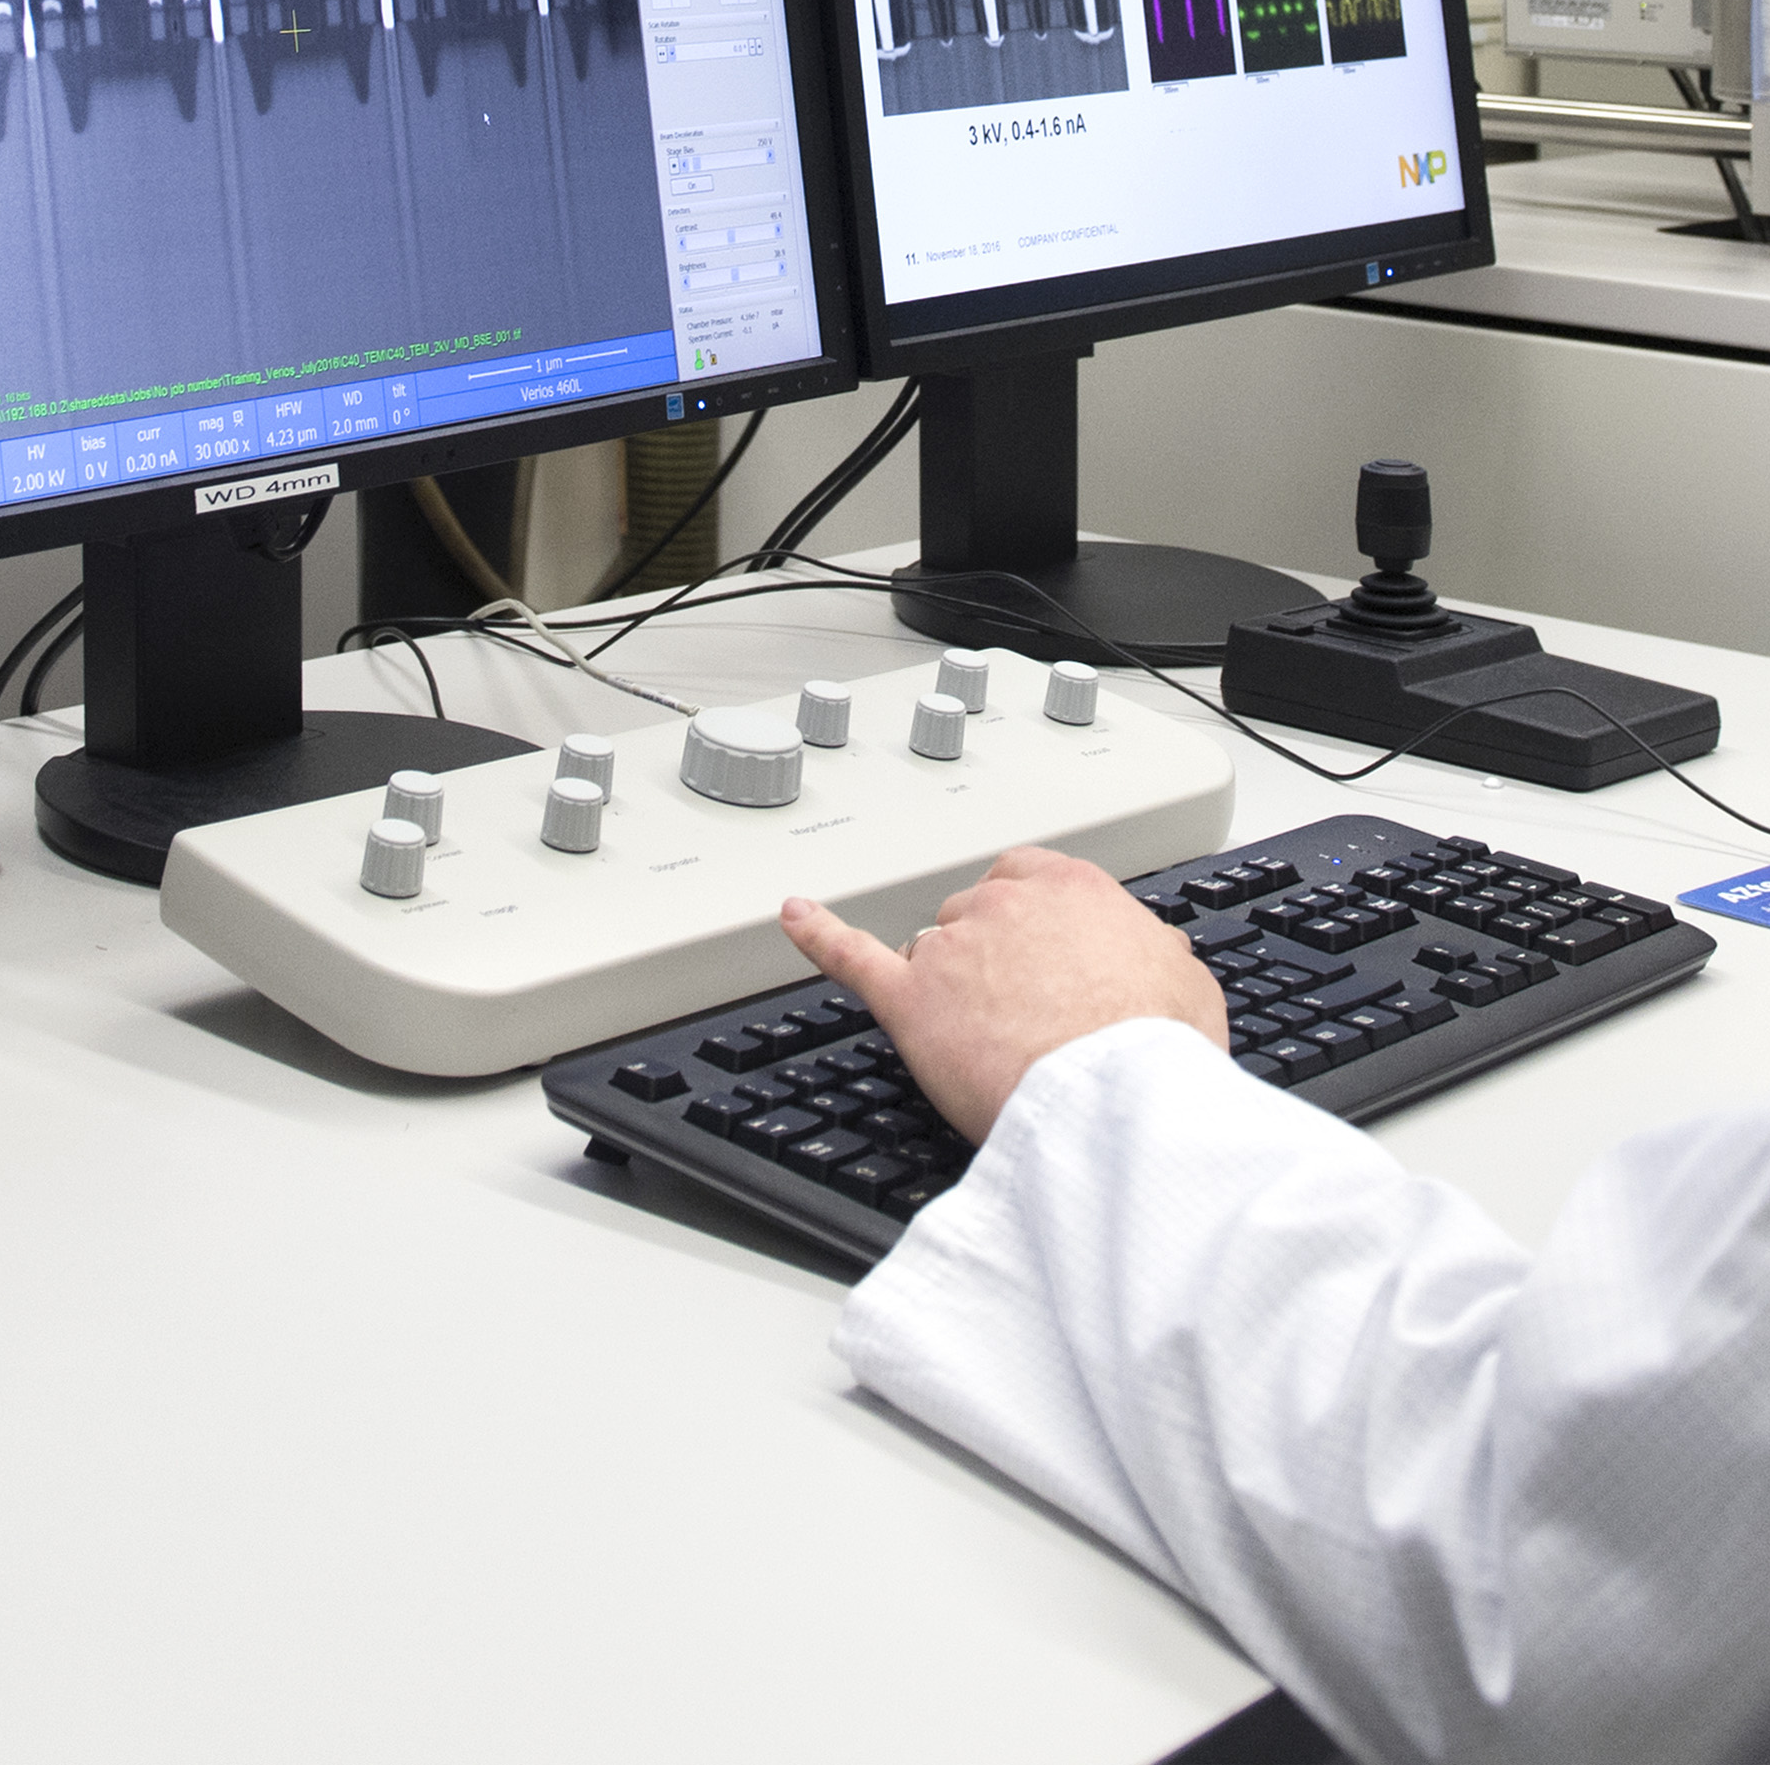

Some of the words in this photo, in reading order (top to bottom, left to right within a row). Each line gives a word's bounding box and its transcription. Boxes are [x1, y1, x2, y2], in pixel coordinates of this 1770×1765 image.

[969, 125, 978, 146] 3
[982, 121, 1008, 147] kV,
[1011, 115, 1063, 141] 0.4-1.6
[1066, 113, 1087, 135] nA
[666, 147, 681, 157] Stage
[683, 146, 694, 154] Bias
[1398, 149, 1447, 189] NXP
[675, 224, 698, 233] Contrast
[905, 252, 920, 266] 11.
[926, 245, 966, 264] November
[982, 240, 1001, 254] 2016
[1018, 232, 1059, 249] COMPANY
[1060, 223, 1119, 244] CONFIDENTIAL
[679, 262, 706, 272] Brightness
[687, 320, 709, 331] Chamber
[688, 333, 712, 344] Specimen
[536, 358, 543, 374] 1
[16, 391, 31, 403] bits
[170, 382, 185, 399] job
[343, 390, 364, 407] WD
[392, 383, 407, 399] tilt
[520, 382, 555, 402] Verios
[557, 377, 583, 397] 460L
[275, 400, 303, 419] HFW
[393, 409, 402, 425] 0
[199, 414, 224, 434] mag
[332, 419, 352, 436] 2.0
[355, 415, 379, 431] mm
[81, 435, 107, 453] bias
[137, 426, 162, 443] curr
[266, 429, 295, 448] 4.23
[27, 443, 46, 462] HV
[195, 443, 212, 462] 30
[215, 438, 240, 458] 000
[242, 439, 251, 454] x
[127, 455, 157, 474] 0.20
[160, 449, 179, 467] nA
[85, 463, 94, 482] 0
[97, 461, 108, 479] V
[13, 475, 45, 495] 2.00
[48, 469, 66, 487] kV
[205, 483, 256, 506] WD
[265, 471, 332, 495] 4mm
